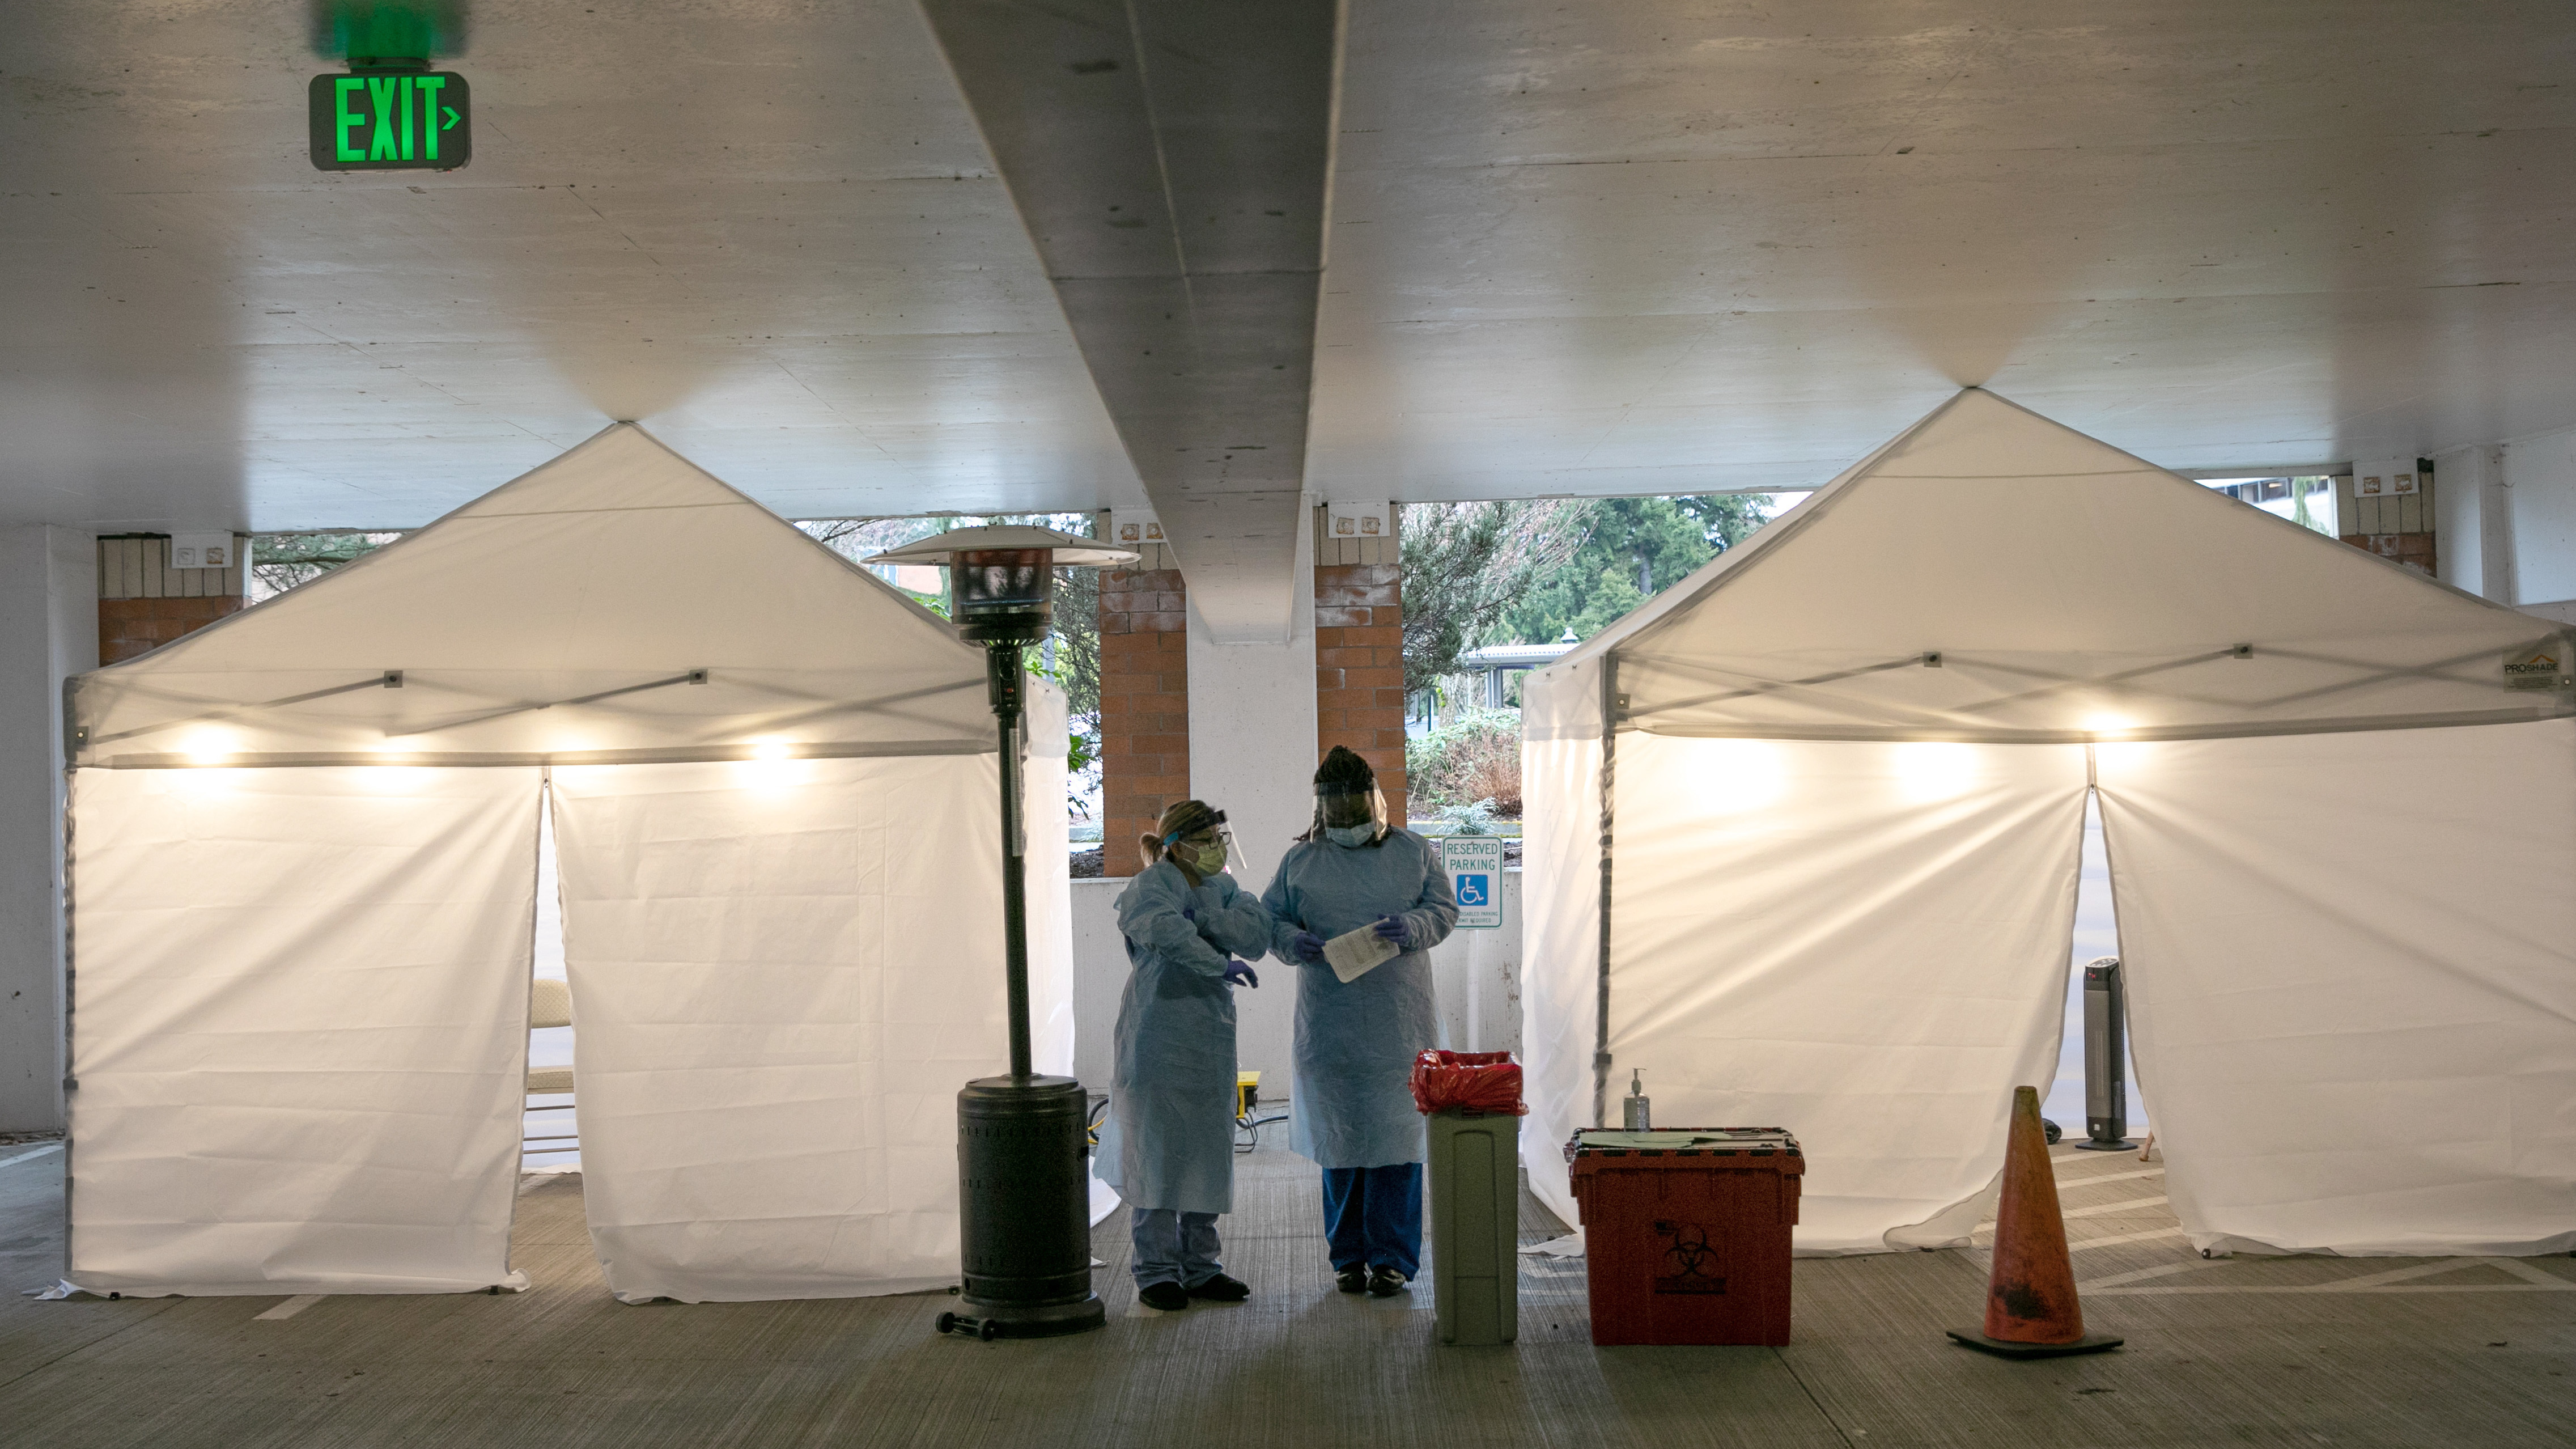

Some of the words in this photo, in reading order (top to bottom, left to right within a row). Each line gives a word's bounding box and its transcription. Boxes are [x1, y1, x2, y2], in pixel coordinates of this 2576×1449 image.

[335, 77, 445, 162] EXIT
[2505, 663, 2558, 673] PROSHADE
[1447, 844, 1497, 854] RESERVED
[1450, 859, 1495, 870] PARKING
